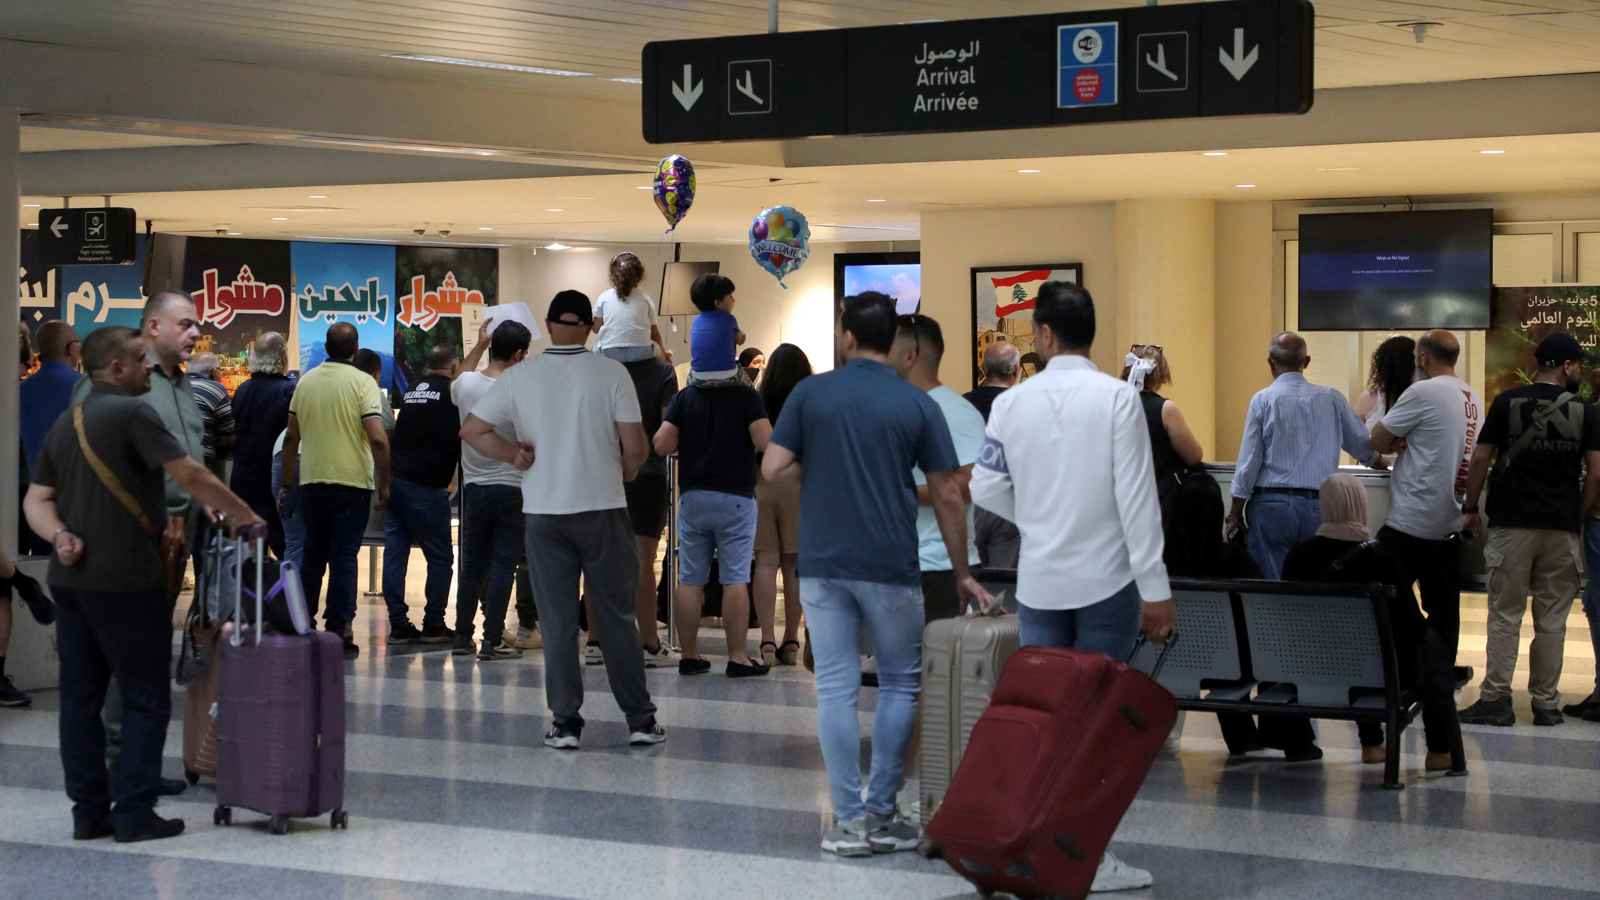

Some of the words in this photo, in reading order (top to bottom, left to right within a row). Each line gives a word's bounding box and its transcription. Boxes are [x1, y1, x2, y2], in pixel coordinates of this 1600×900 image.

[914, 40, 980, 65] الوصول
[916, 65, 976, 87] Arrival
[913, 91, 979, 112] Arrivée
[756, 243, 801, 258] WELCOME
[19, 266, 56, 322] لبن
[191, 264, 285, 330] مشوار
[298, 276, 389, 325] رايحين
[1590, 294, 1599, 307] 5
[1520, 311, 1562, 332] العالمي
[1566, 311, 1597, 329] اليوم
